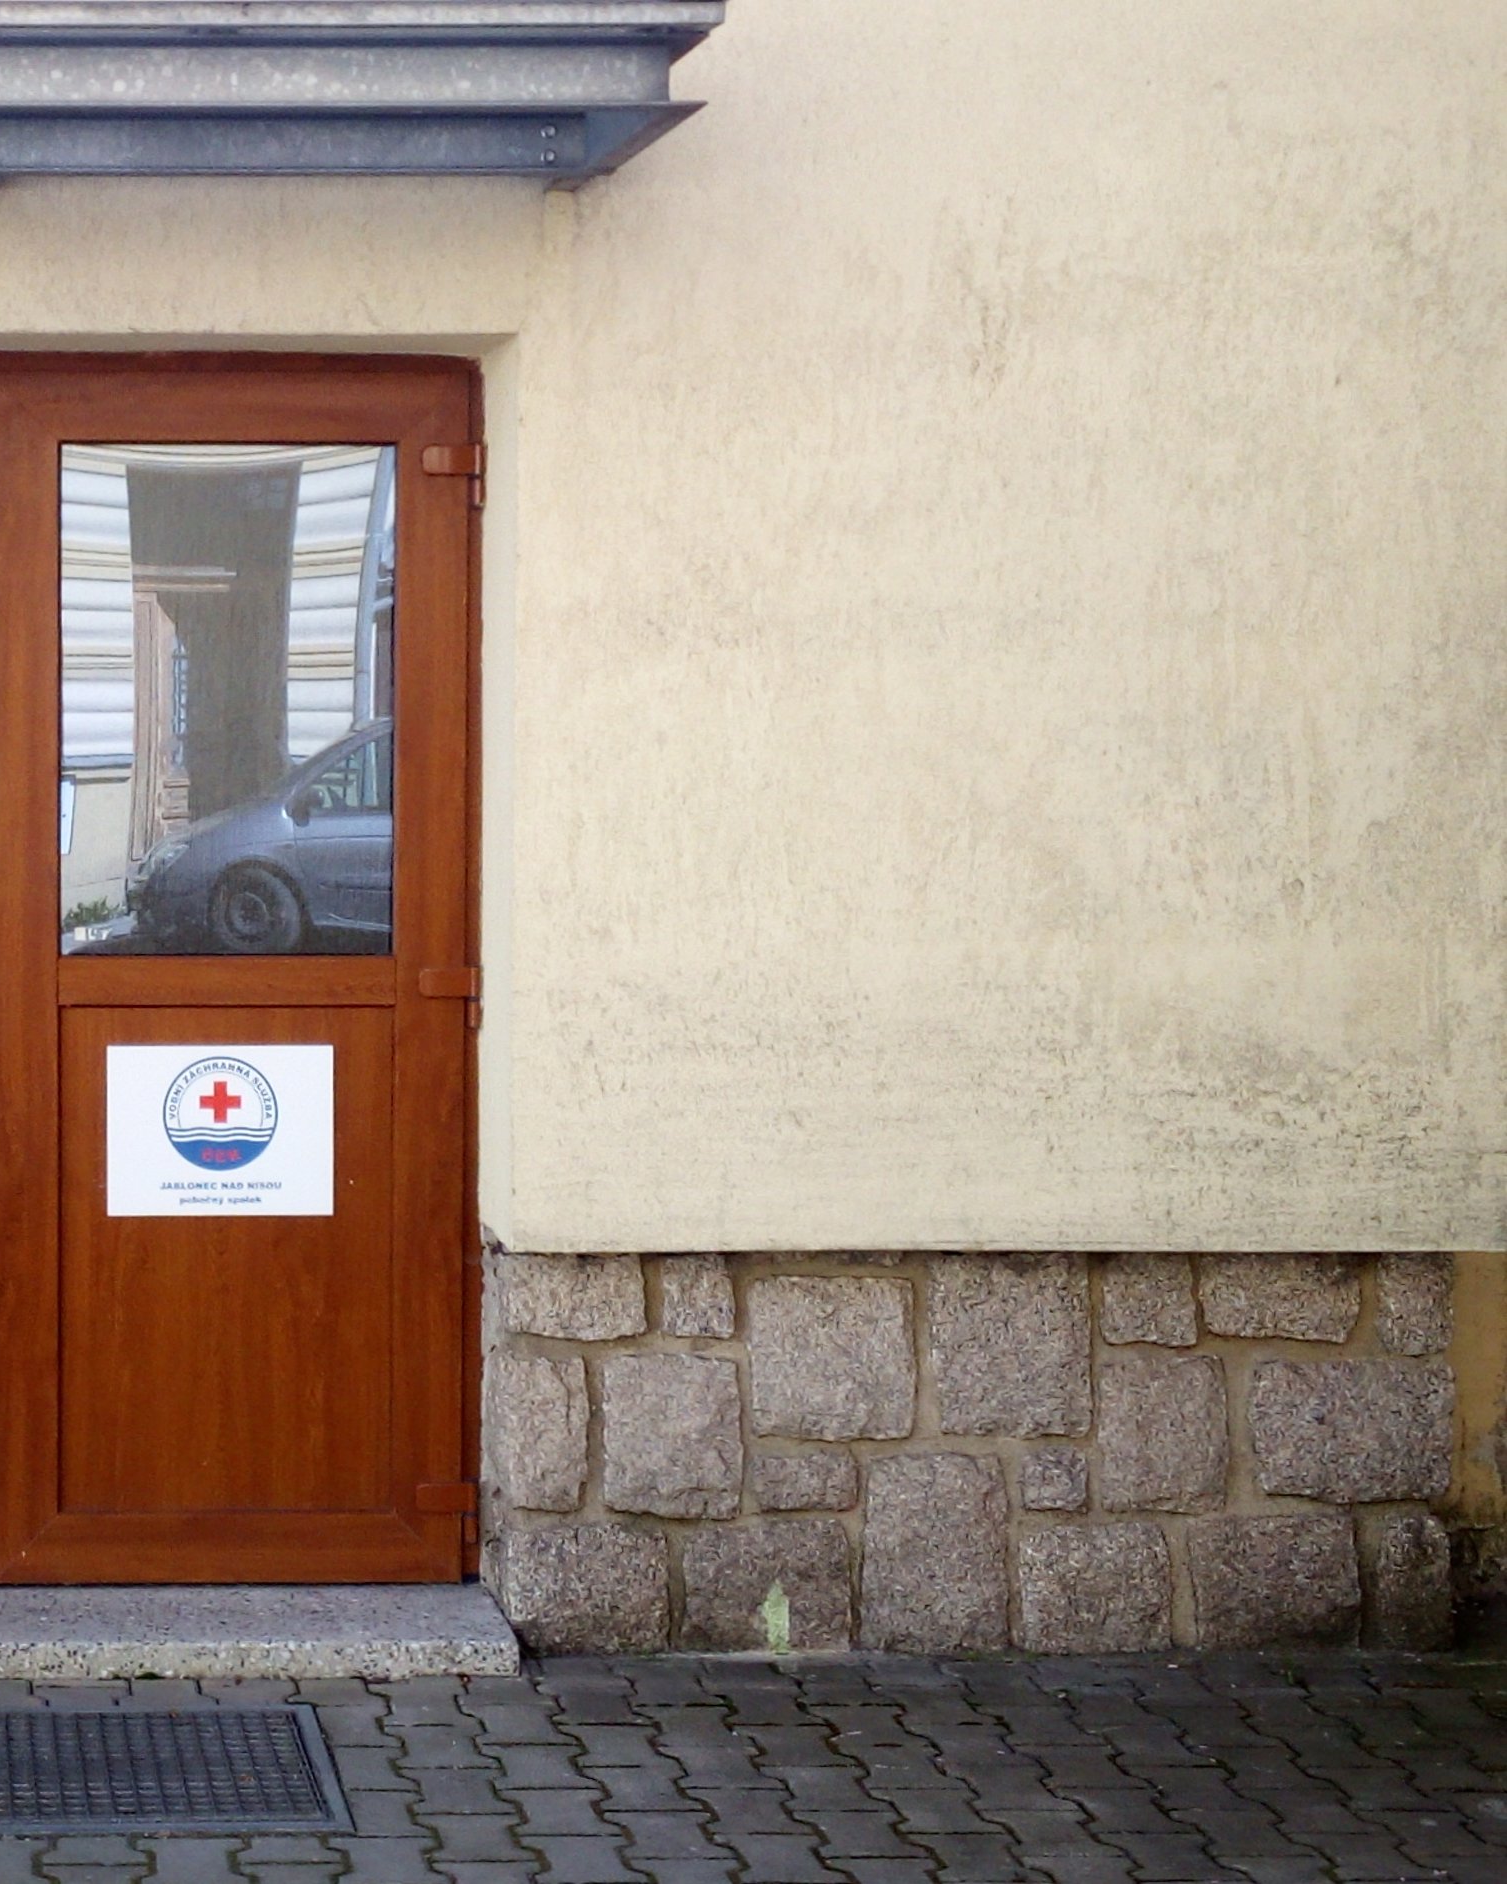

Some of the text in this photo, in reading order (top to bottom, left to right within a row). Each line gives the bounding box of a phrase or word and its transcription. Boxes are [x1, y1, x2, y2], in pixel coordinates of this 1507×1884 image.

[160, 1182, 282, 1190] JABLONEC NAD NISOU
